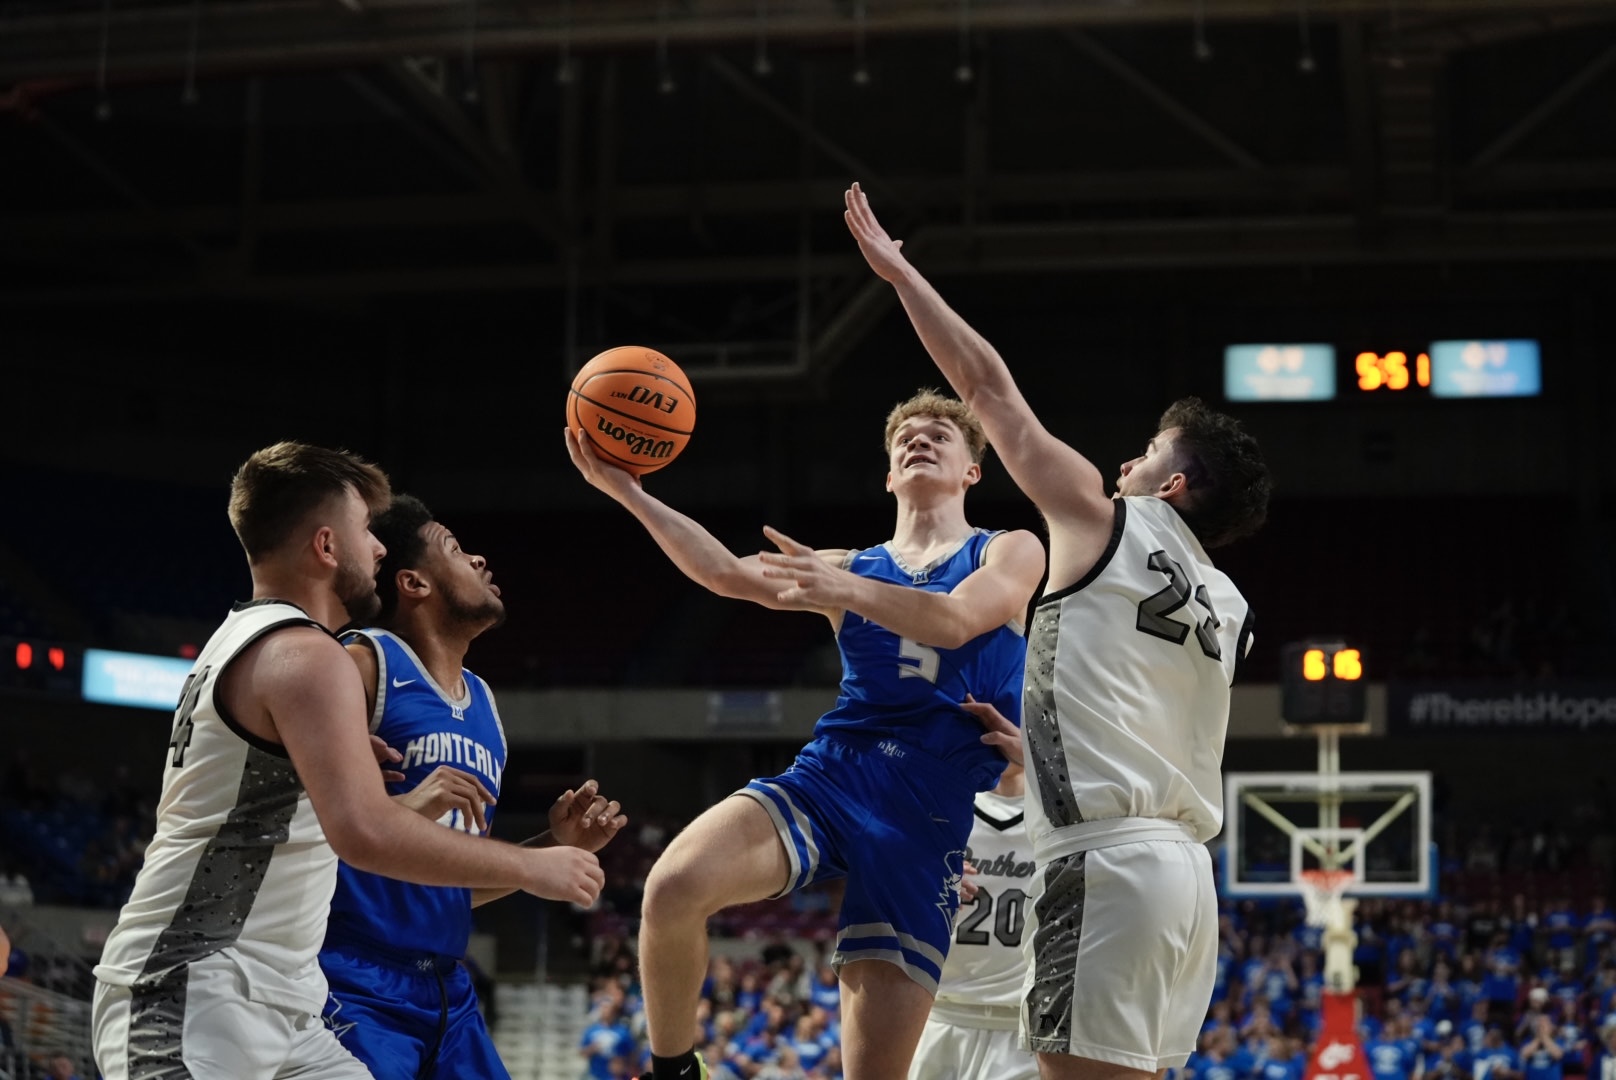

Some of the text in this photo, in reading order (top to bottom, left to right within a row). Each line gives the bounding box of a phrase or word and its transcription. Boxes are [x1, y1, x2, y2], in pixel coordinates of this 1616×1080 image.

[627, 386, 679, 414] EVO
[598, 416, 675, 458] Wilson
[956, 886, 1026, 947] 20
